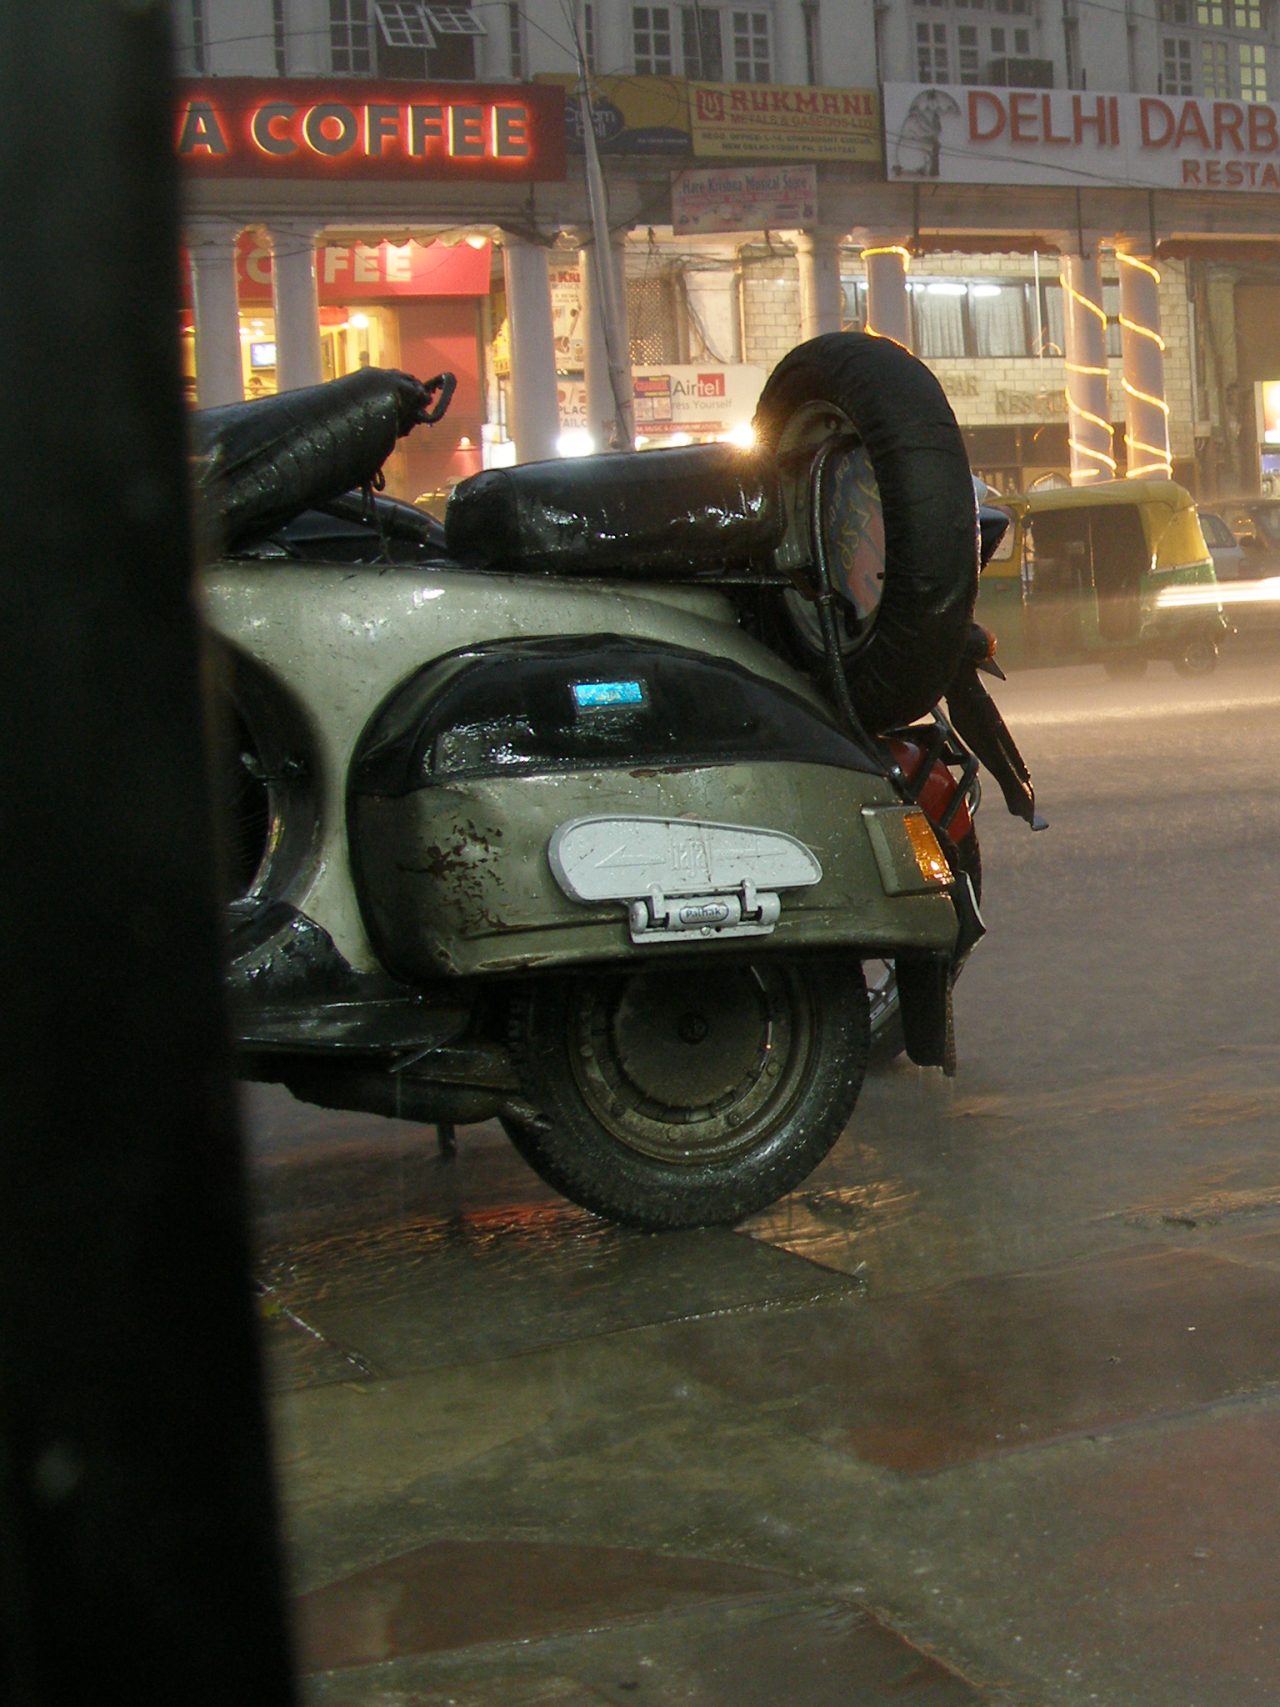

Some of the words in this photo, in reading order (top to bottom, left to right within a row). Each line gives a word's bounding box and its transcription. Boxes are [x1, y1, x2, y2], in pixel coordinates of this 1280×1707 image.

[731, 89, 873, 115] RUKMANI
[250, 101, 529, 158] COFFEE
[967, 90, 1121, 146] DELHI
[673, 379, 720, 396] Airtel
[694, 399, 732, 409] Yourself
